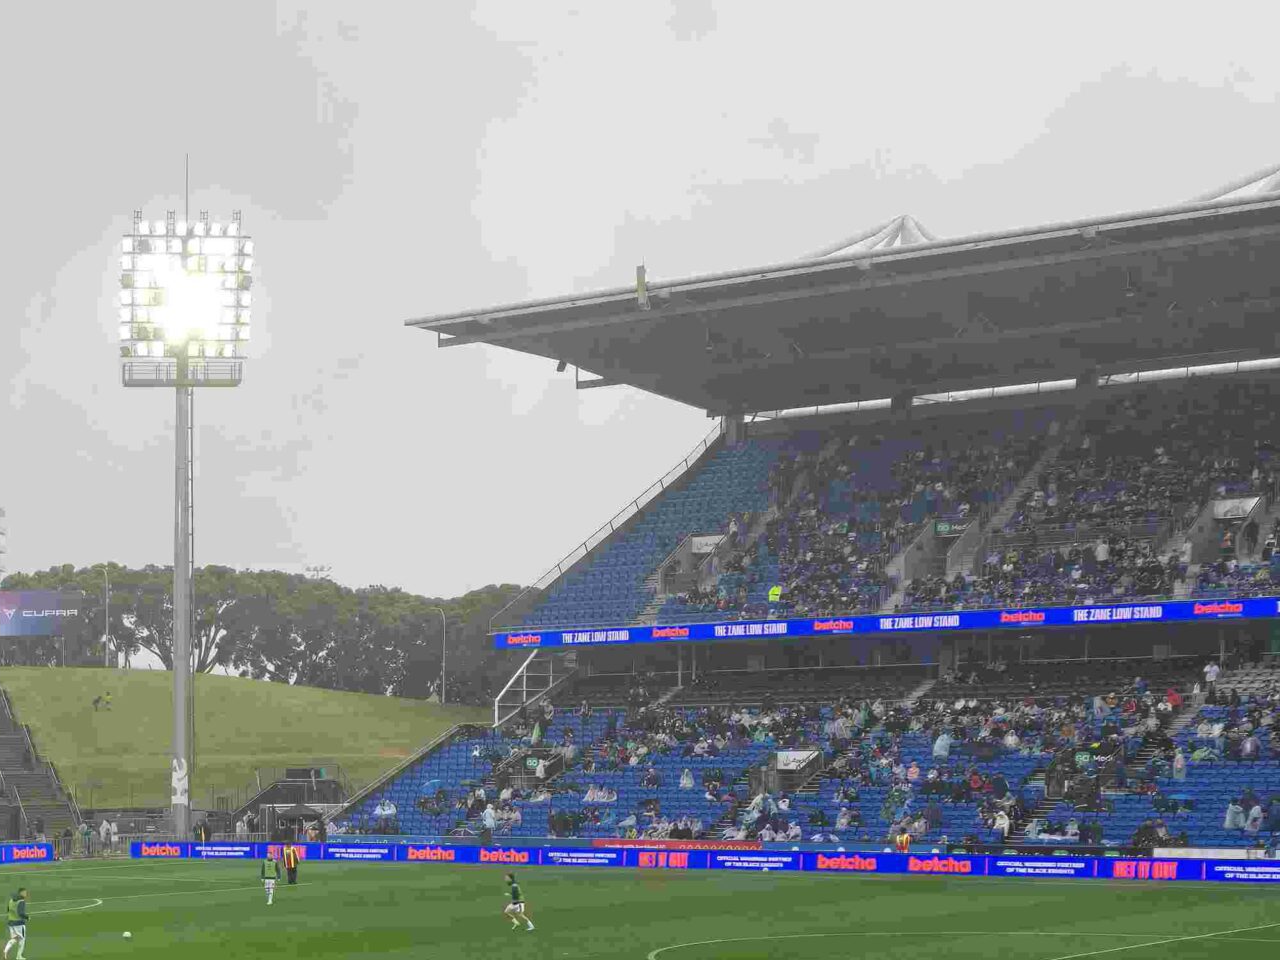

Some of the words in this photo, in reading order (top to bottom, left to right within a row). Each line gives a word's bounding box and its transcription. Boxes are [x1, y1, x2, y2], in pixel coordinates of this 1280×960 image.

[22, 608, 78, 617] CUPRA
[1134, 606, 1163, 619] STAND
[934, 615, 960, 627] STAND
[408, 847, 455, 861] betcha
[480, 848, 529, 863] betcha
[817, 854, 877, 870] betcha
[908, 856, 971, 873] betcha
